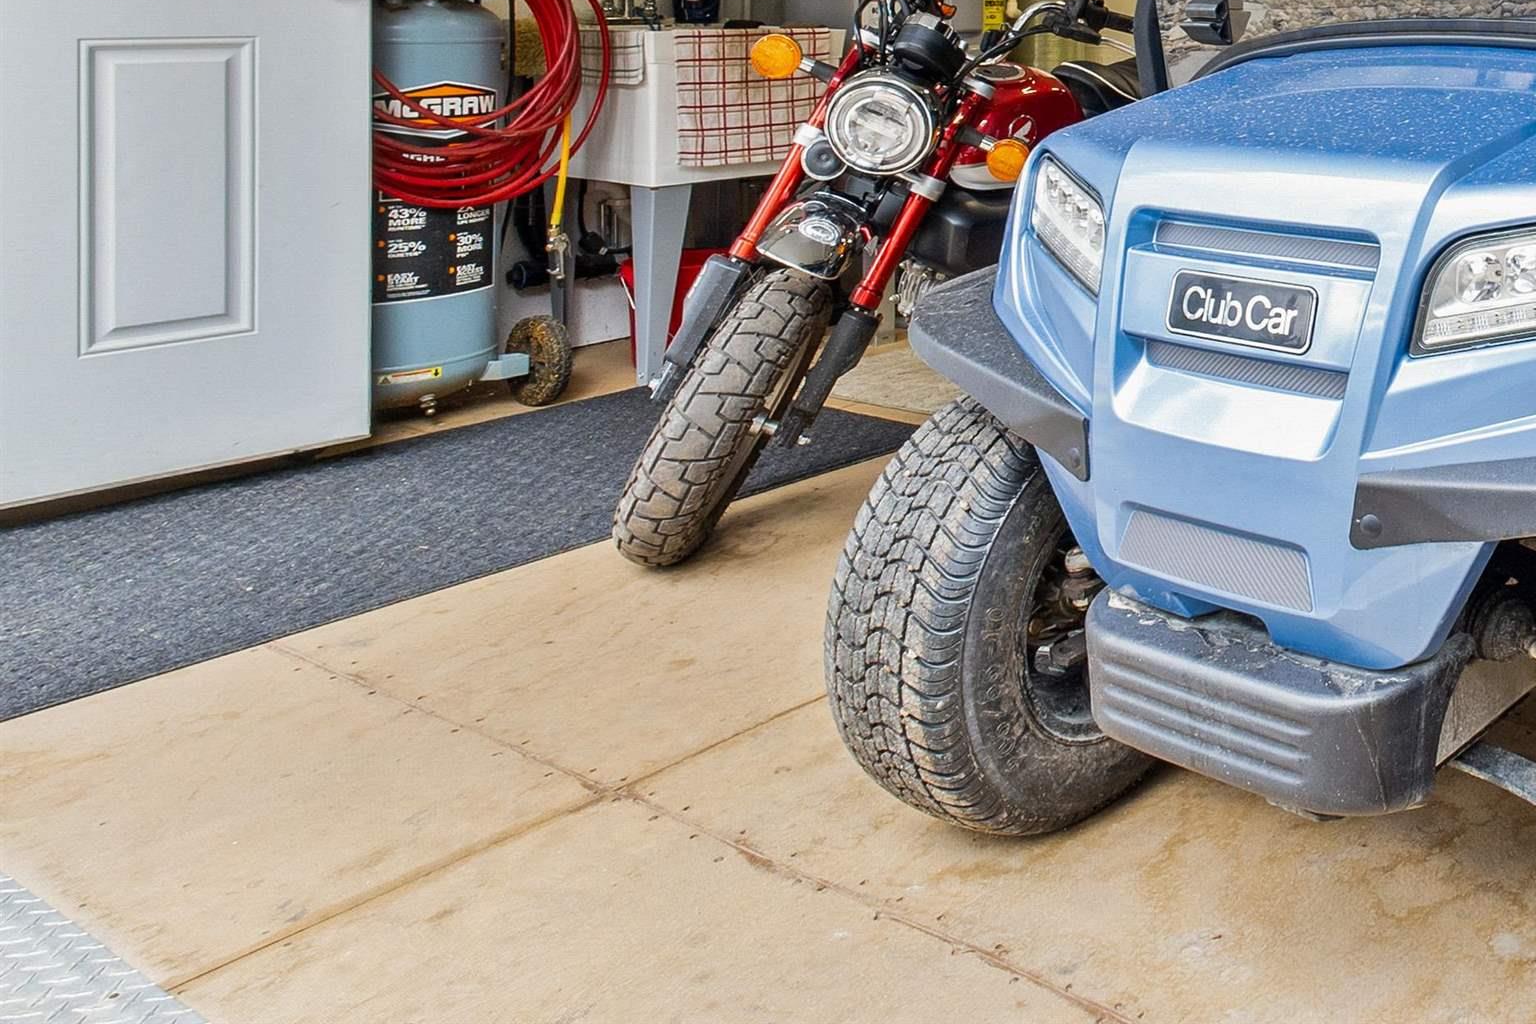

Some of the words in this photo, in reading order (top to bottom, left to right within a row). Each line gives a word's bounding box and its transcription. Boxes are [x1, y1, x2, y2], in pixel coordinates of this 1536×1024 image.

[388, 208, 427, 219] 43%
[457, 209, 490, 220] LONGER
[388, 217, 427, 226] MORE
[457, 234, 483, 245] 30%
[388, 241, 427, 253] 25%
[457, 243, 483, 253] MORE
[1182, 285, 1242, 327] Club
[1246, 295, 1298, 336] Car
